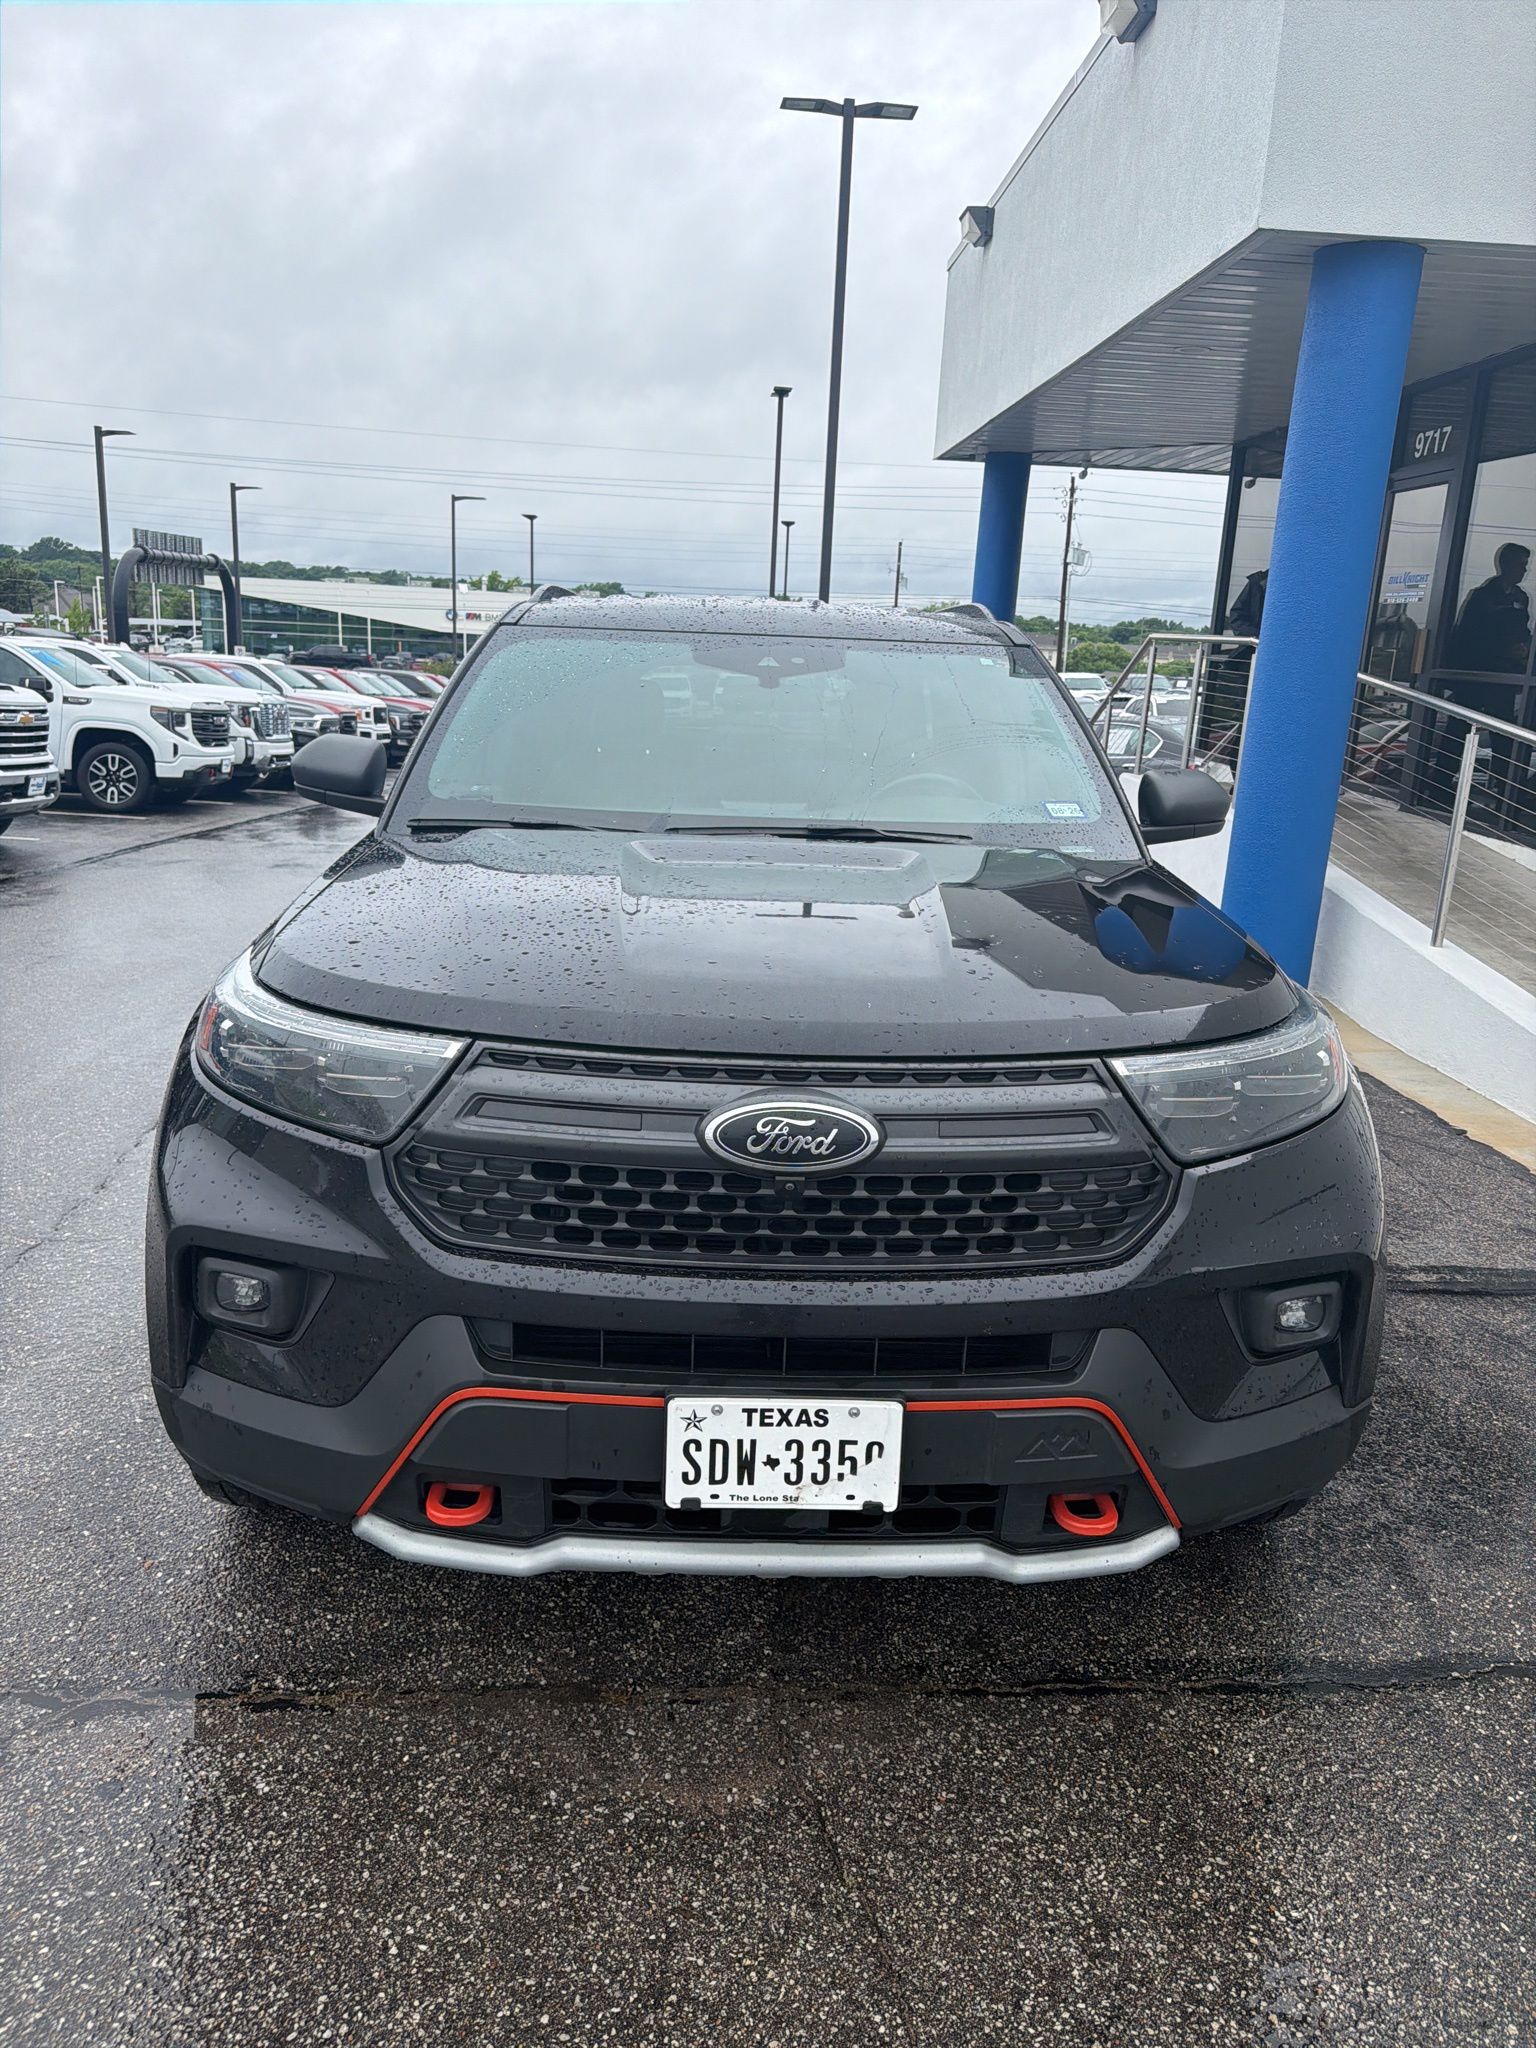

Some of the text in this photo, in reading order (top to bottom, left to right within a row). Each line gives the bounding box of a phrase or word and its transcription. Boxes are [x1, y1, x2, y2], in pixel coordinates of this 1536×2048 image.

[1414, 425, 1453, 459] 9717
[746, 1116, 839, 1155] Ford
[741, 1408, 829, 1428] TEXAS
[681, 1438, 757, 1486] SDW
[729, 1494, 750, 1502] The
[753, 1494, 779, 1502] Lone
